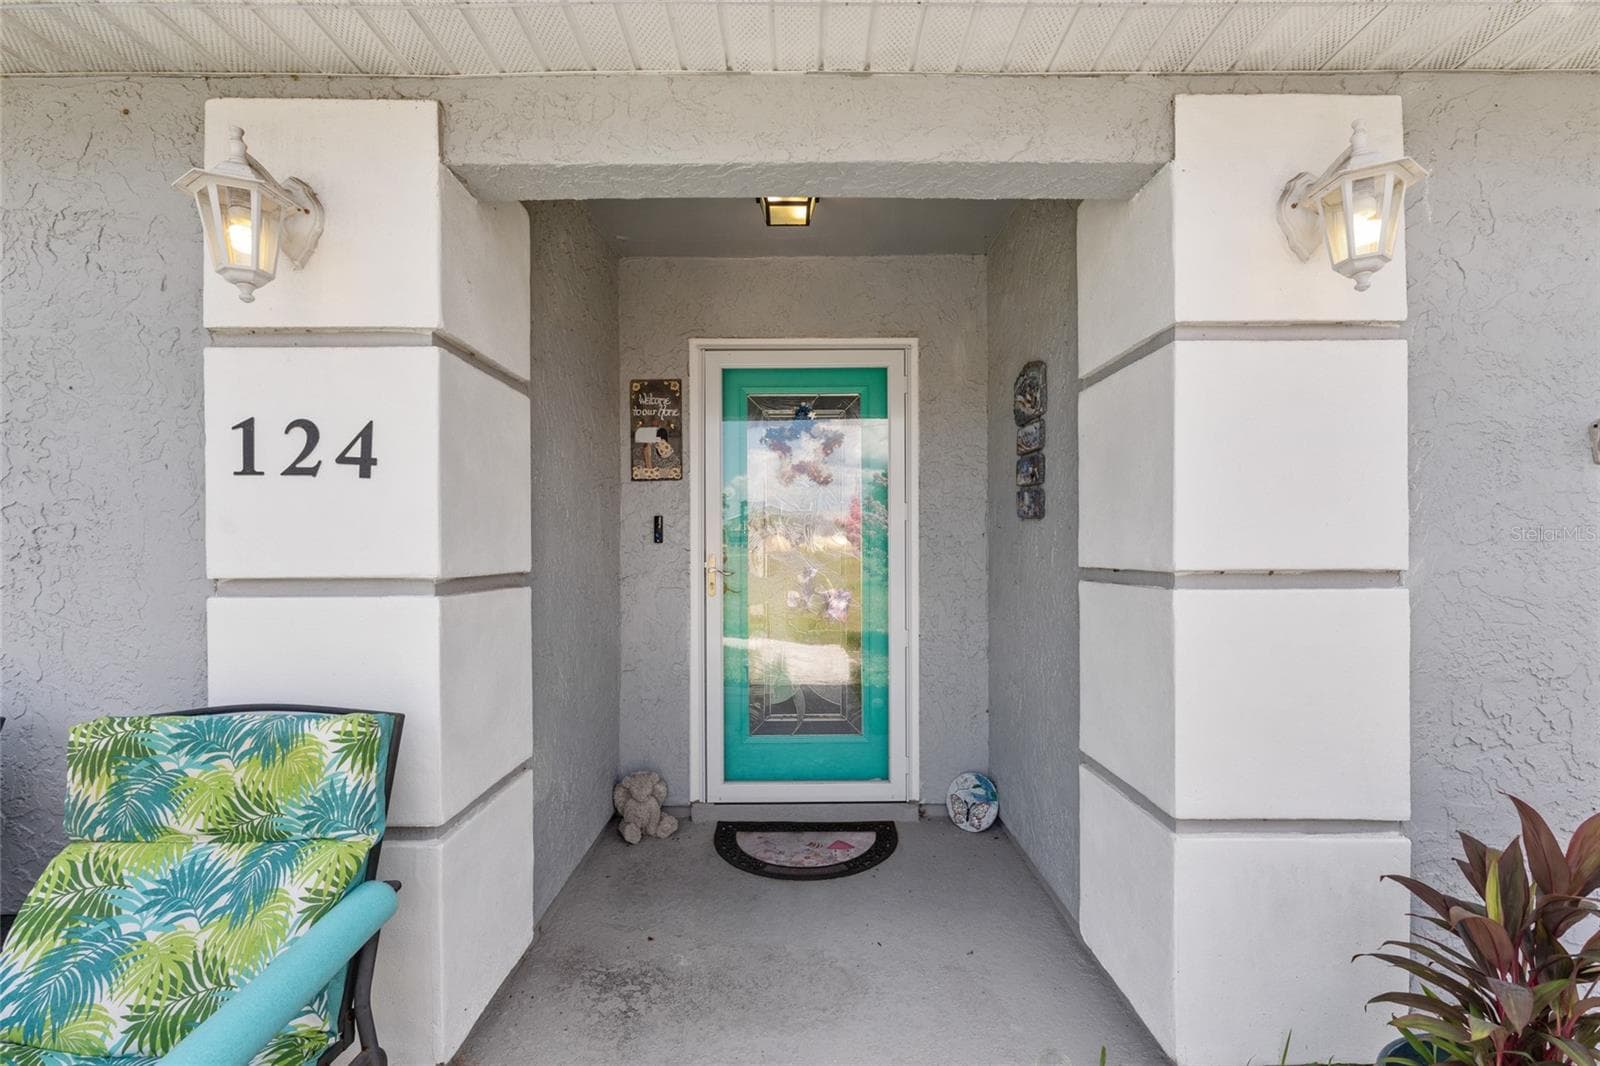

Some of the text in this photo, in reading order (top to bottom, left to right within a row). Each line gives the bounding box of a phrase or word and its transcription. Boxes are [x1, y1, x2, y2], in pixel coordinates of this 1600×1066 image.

[638, 393, 671, 405] Welcome
[633, 405, 641, 416] to
[642, 408, 657, 416] our
[231, 416, 378, 479] 124
